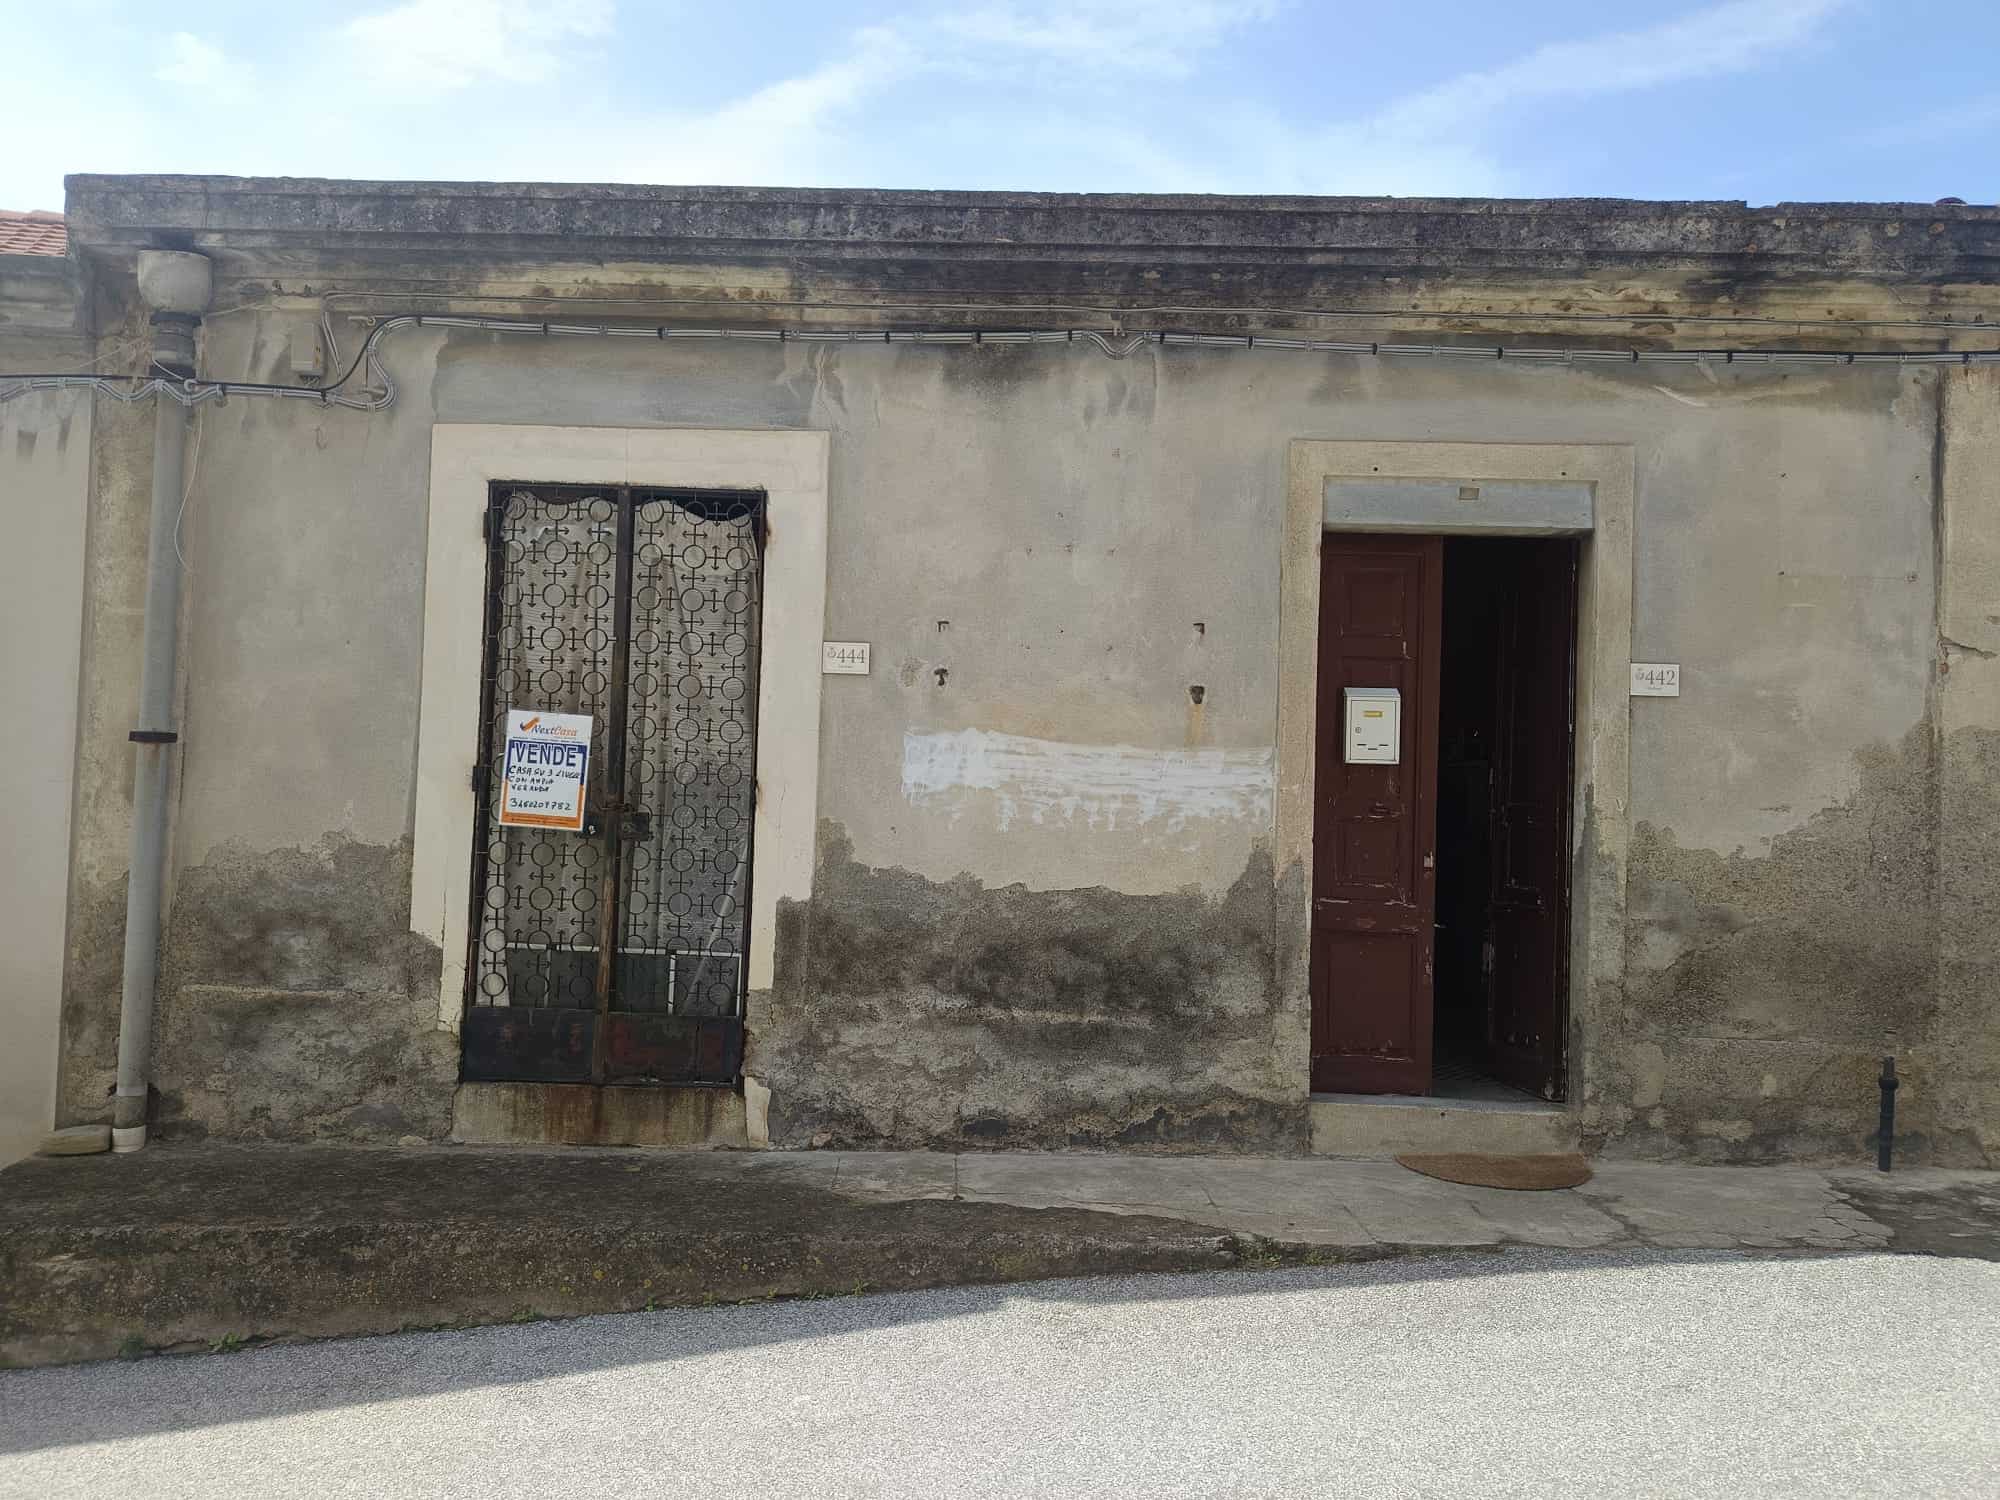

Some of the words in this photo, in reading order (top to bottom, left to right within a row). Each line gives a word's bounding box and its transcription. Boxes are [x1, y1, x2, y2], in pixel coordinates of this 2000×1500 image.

[531, 724, 577, 737] NextCasa
[515, 742, 577, 767] VENDE
[508, 765, 532, 776] CASA
